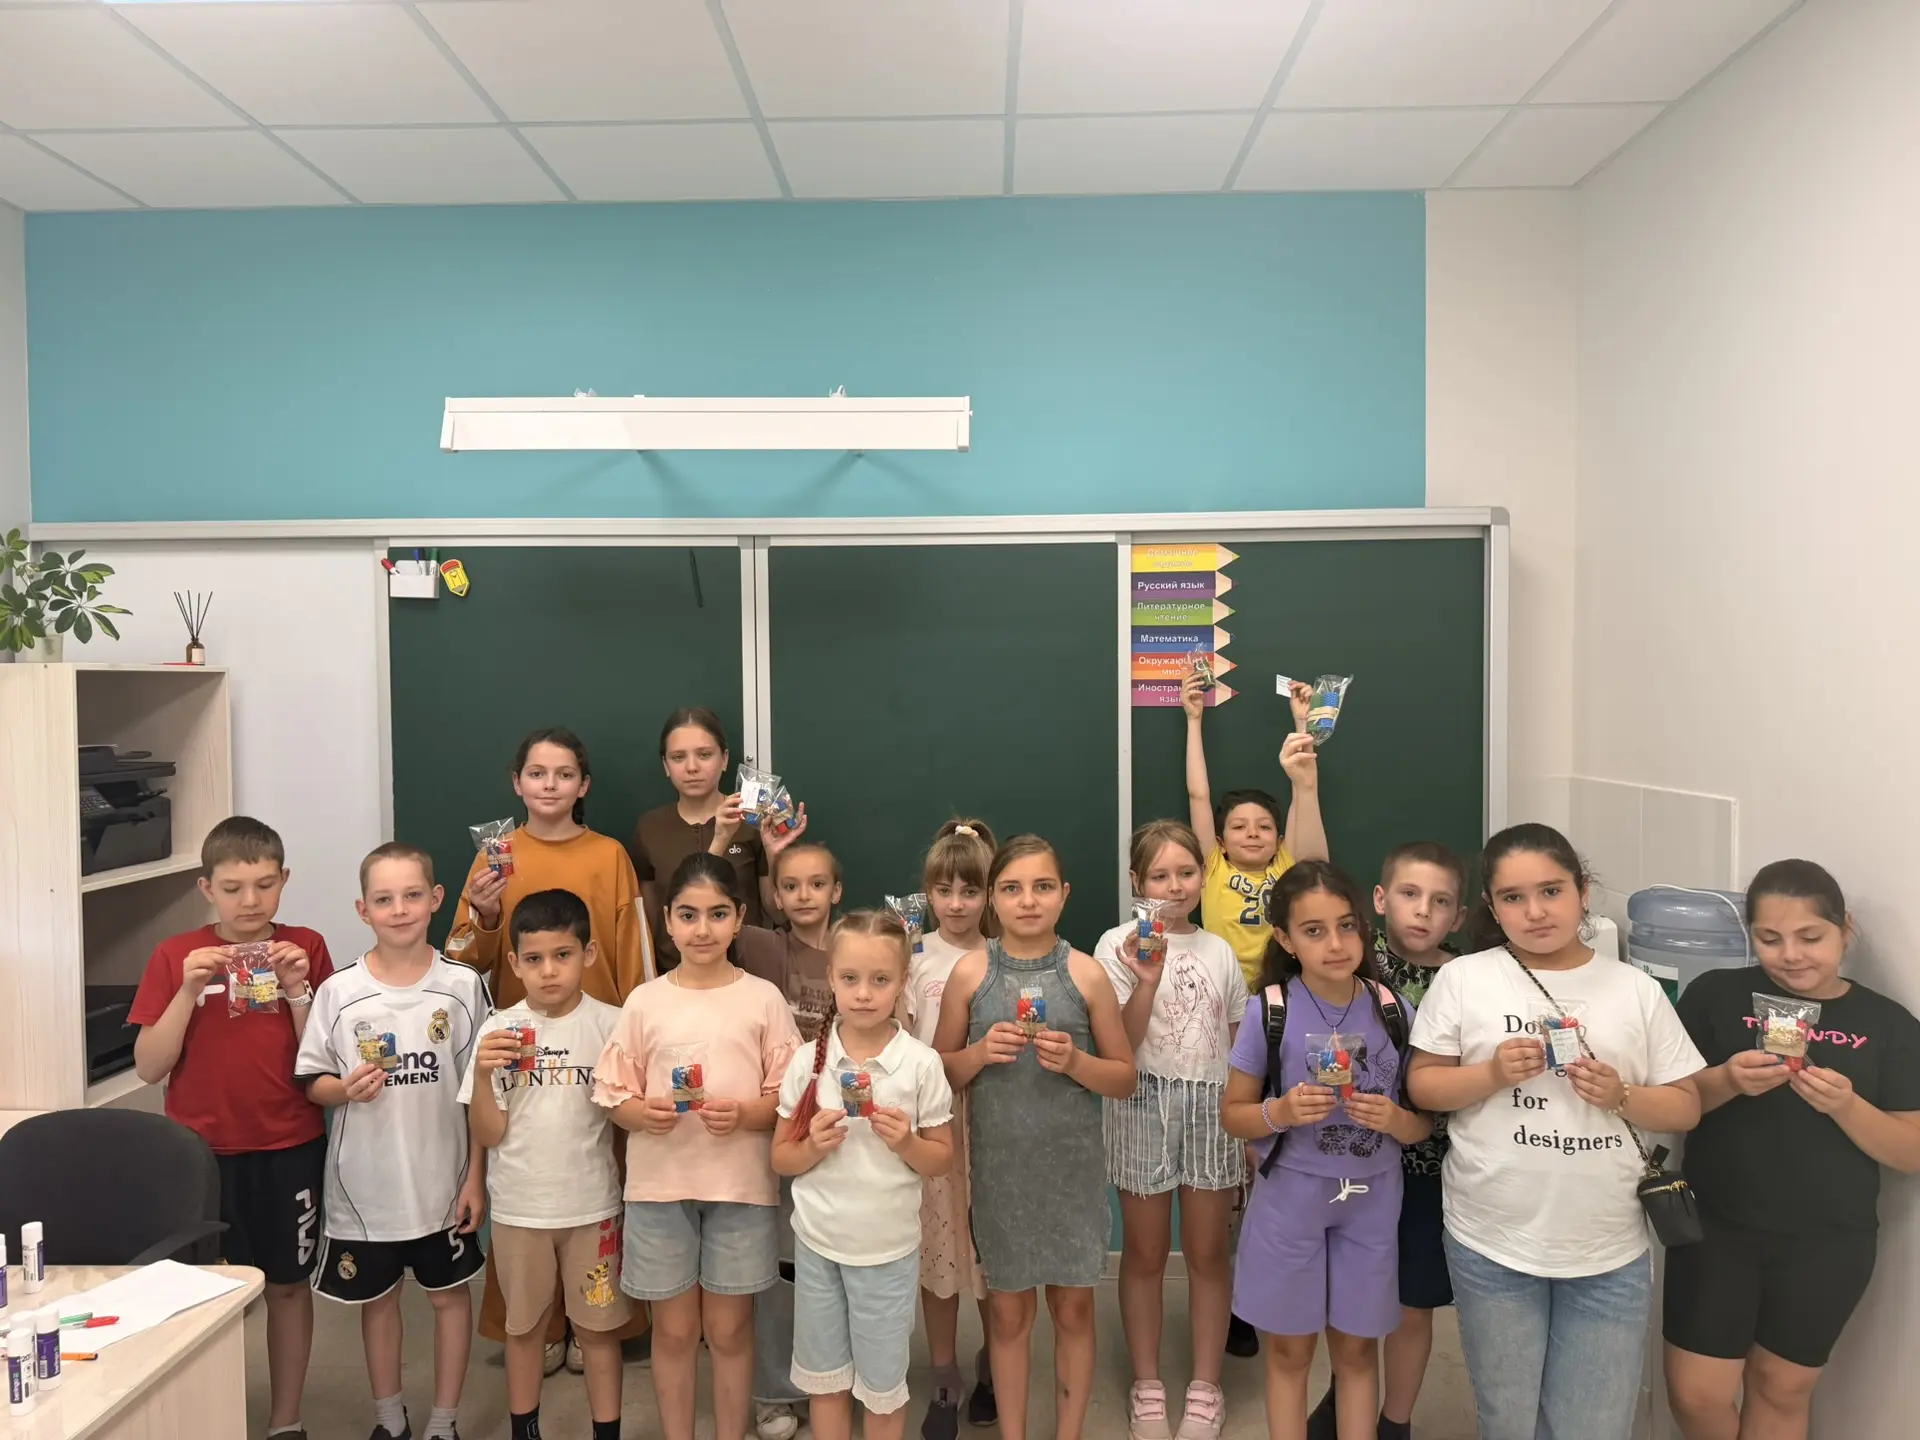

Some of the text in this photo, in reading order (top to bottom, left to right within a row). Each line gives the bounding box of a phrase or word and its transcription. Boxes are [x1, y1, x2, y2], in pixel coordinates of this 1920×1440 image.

[1137, 581, 1178, 591] Русский
[1136, 602, 1206, 612] Литературное
[1140, 634, 1199, 643] Математика
[1161, 669, 1181, 678] мир
[1138, 683, 1182, 694] Иностра
[729, 844, 742, 854] alo
[536, 1058, 567, 1068] THE
[384, 1070, 439, 1087] EMENS
[548, 1067, 593, 1086] KIN
[1511, 1087, 1548, 1110] for
[1513, 1125, 1623, 1155] designers
